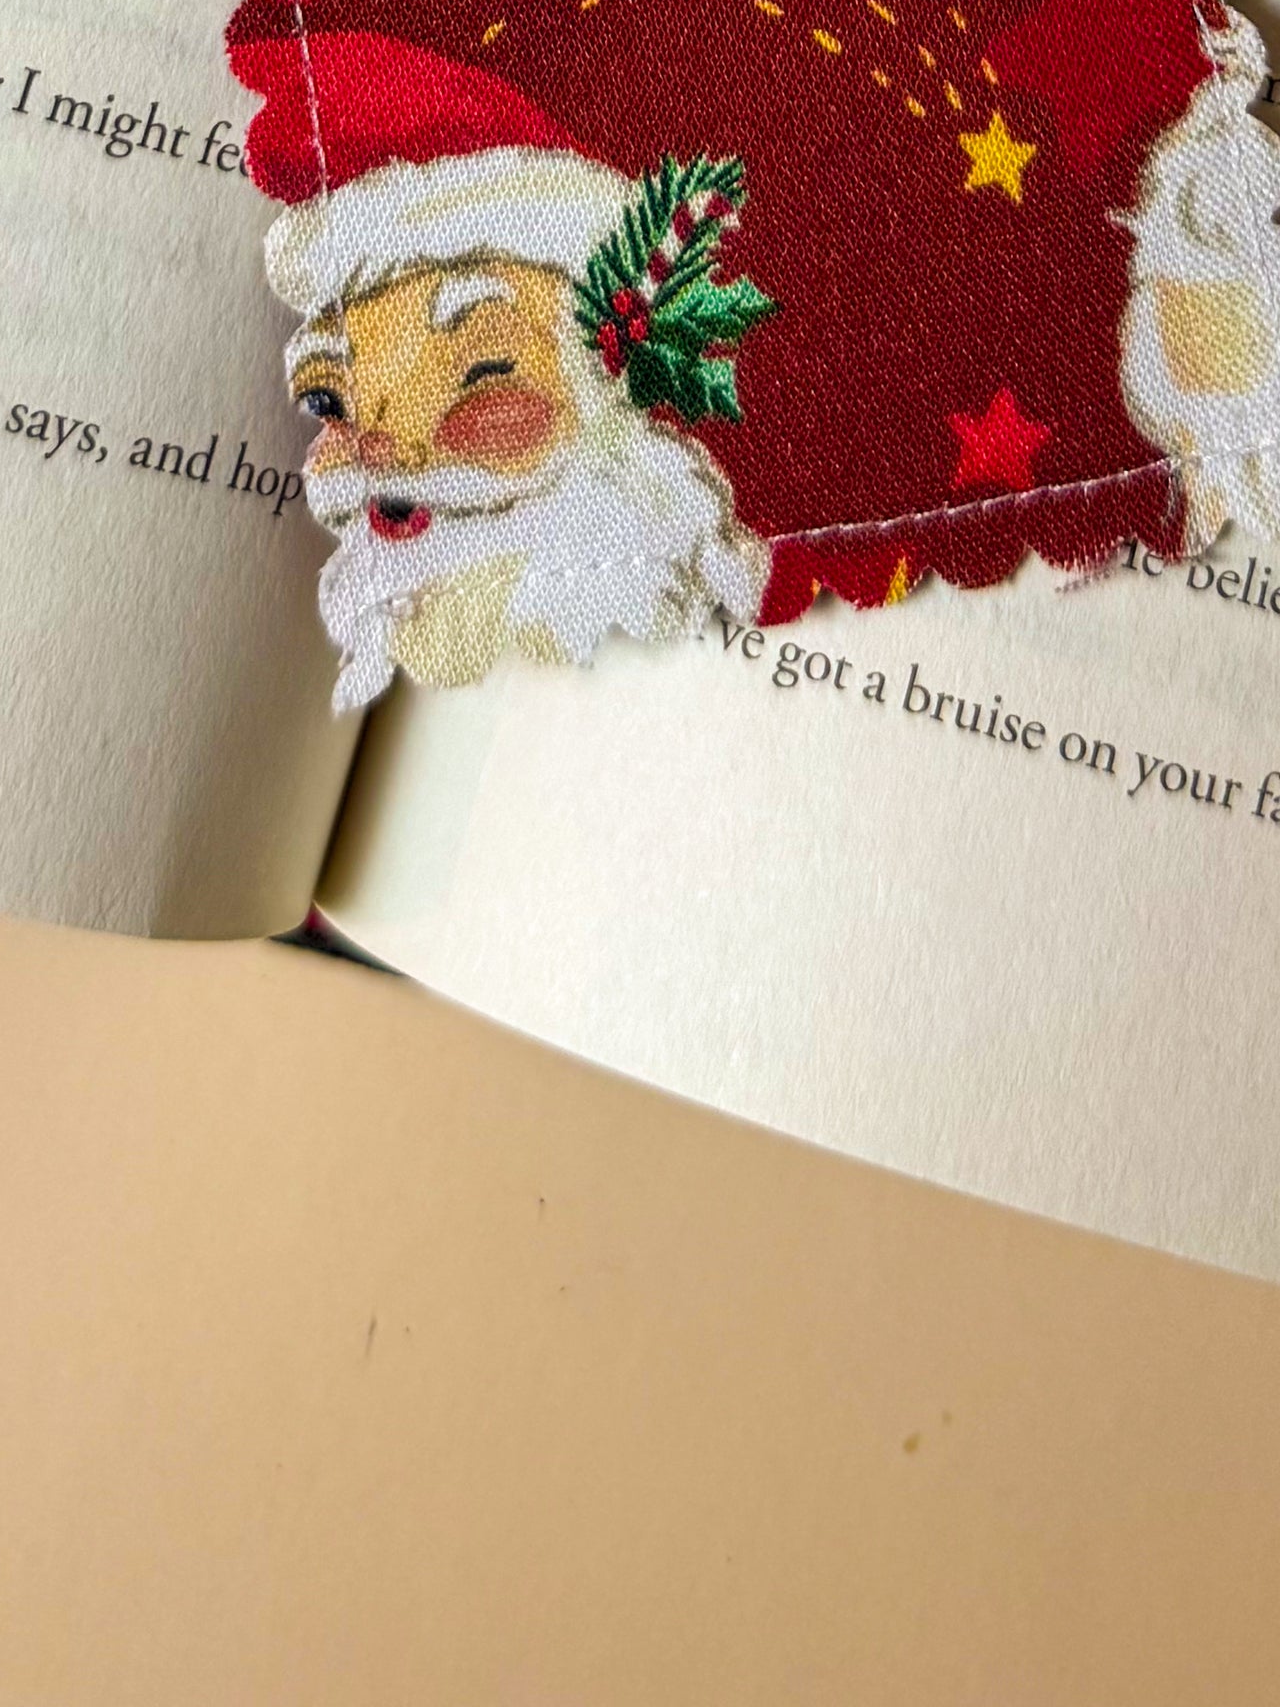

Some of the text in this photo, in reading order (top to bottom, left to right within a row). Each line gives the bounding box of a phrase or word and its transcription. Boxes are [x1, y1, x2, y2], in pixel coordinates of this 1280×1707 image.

[4, 403, 108, 464] says,
[128, 433, 219, 485] and
[771, 642, 853, 691] got
[862, 671, 886, 705] a
[902, 663, 1047, 753] bruise
[1058, 732, 1117, 777] on
[1126, 752, 1243, 812] your
